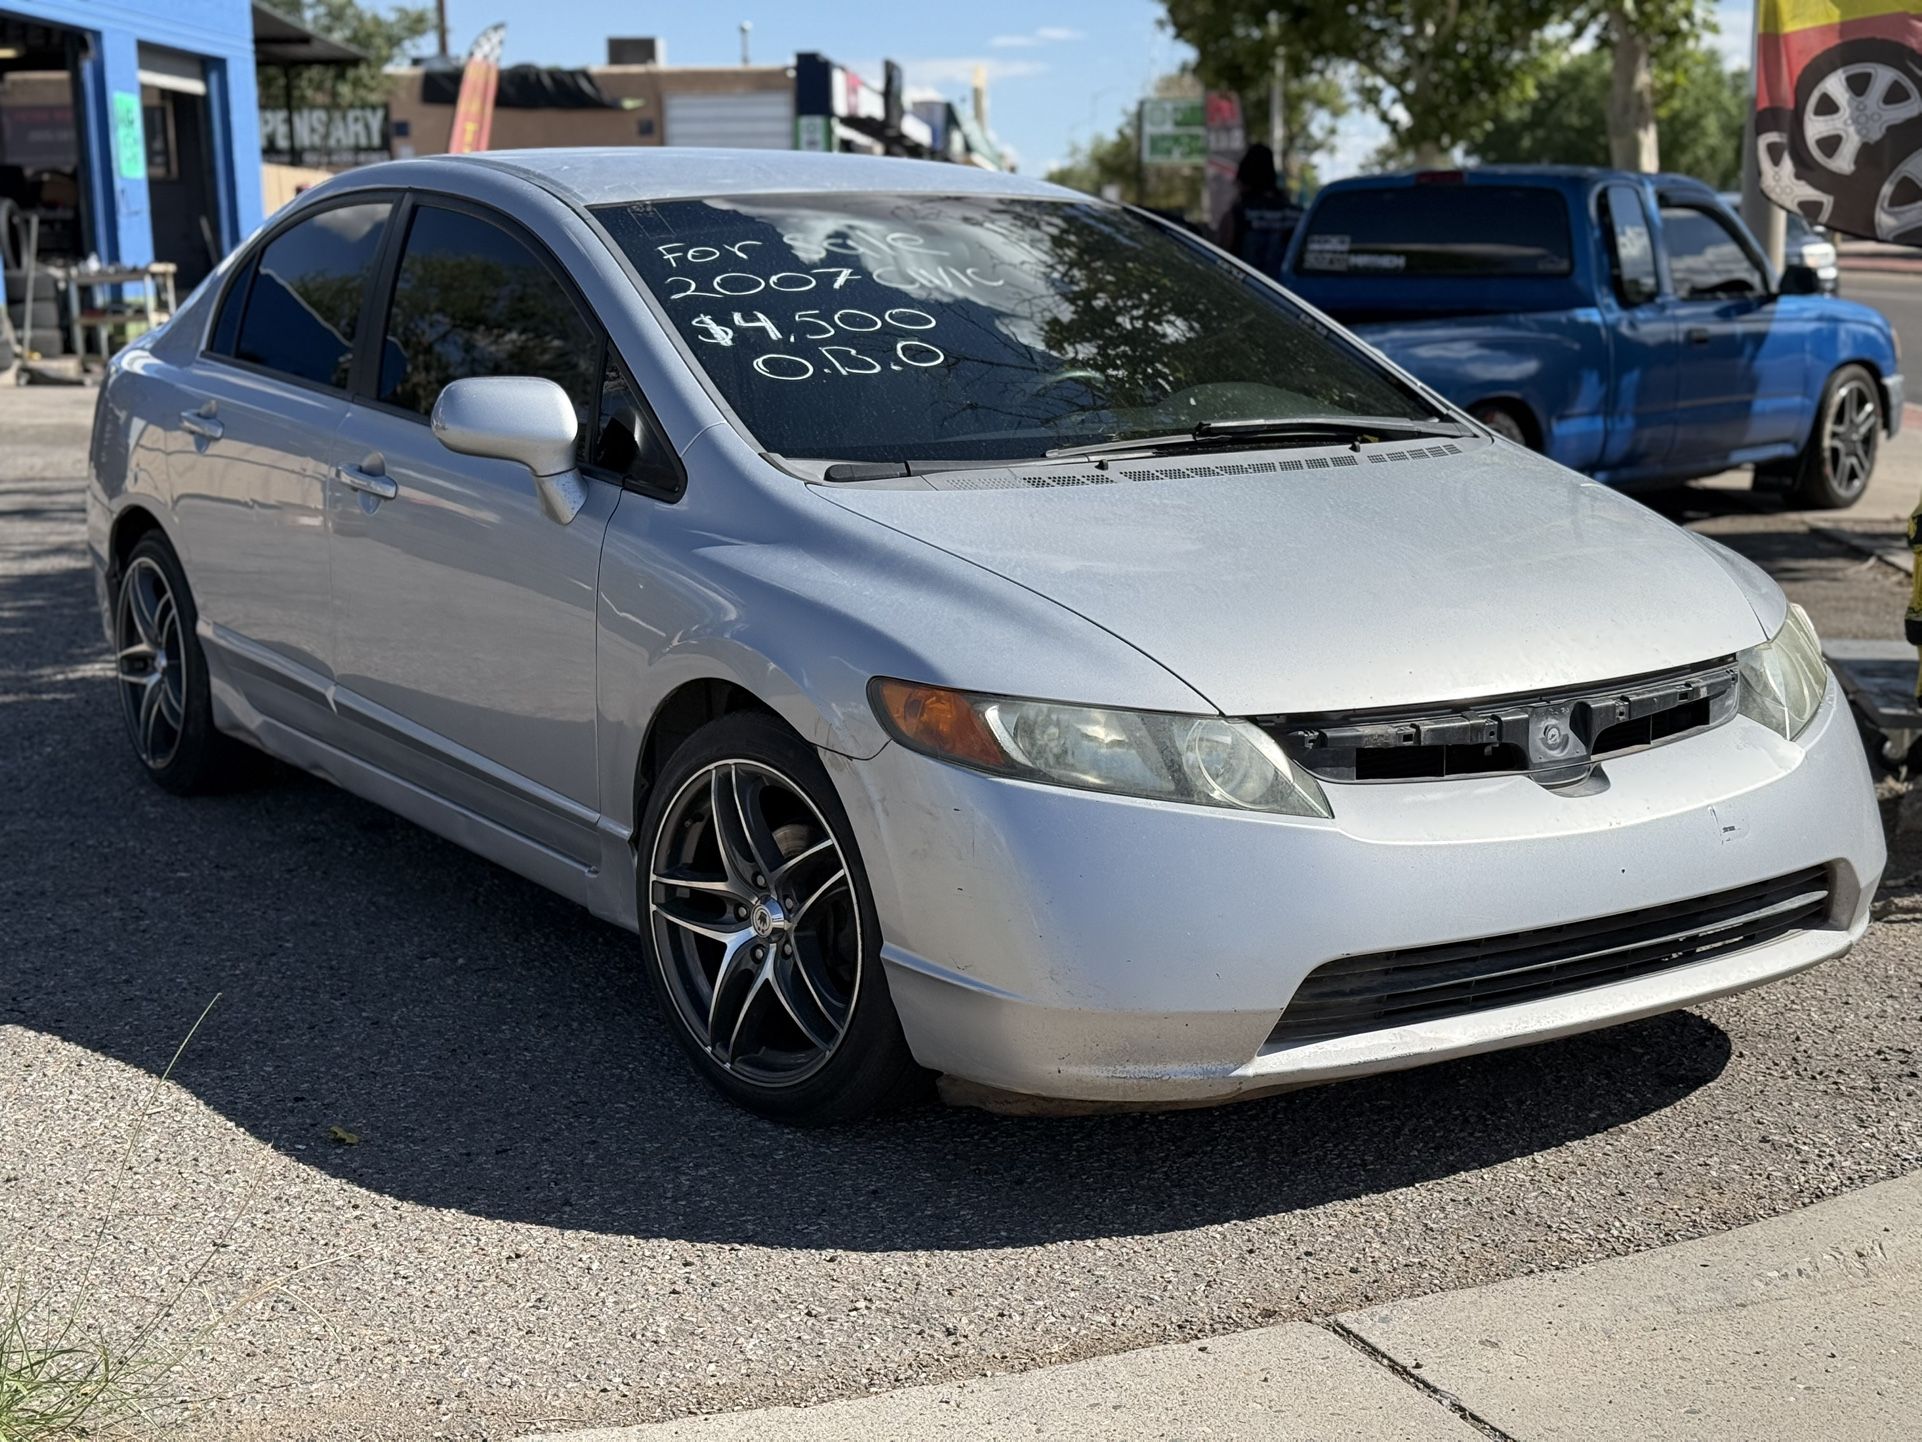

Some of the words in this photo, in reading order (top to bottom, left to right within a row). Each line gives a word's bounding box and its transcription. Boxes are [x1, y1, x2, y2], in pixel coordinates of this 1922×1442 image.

[656, 241, 763, 268] For
[664, 267, 862, 300] 2007
[691, 307, 937, 347] $4,500
[752, 340, 945, 381] O.B.O
